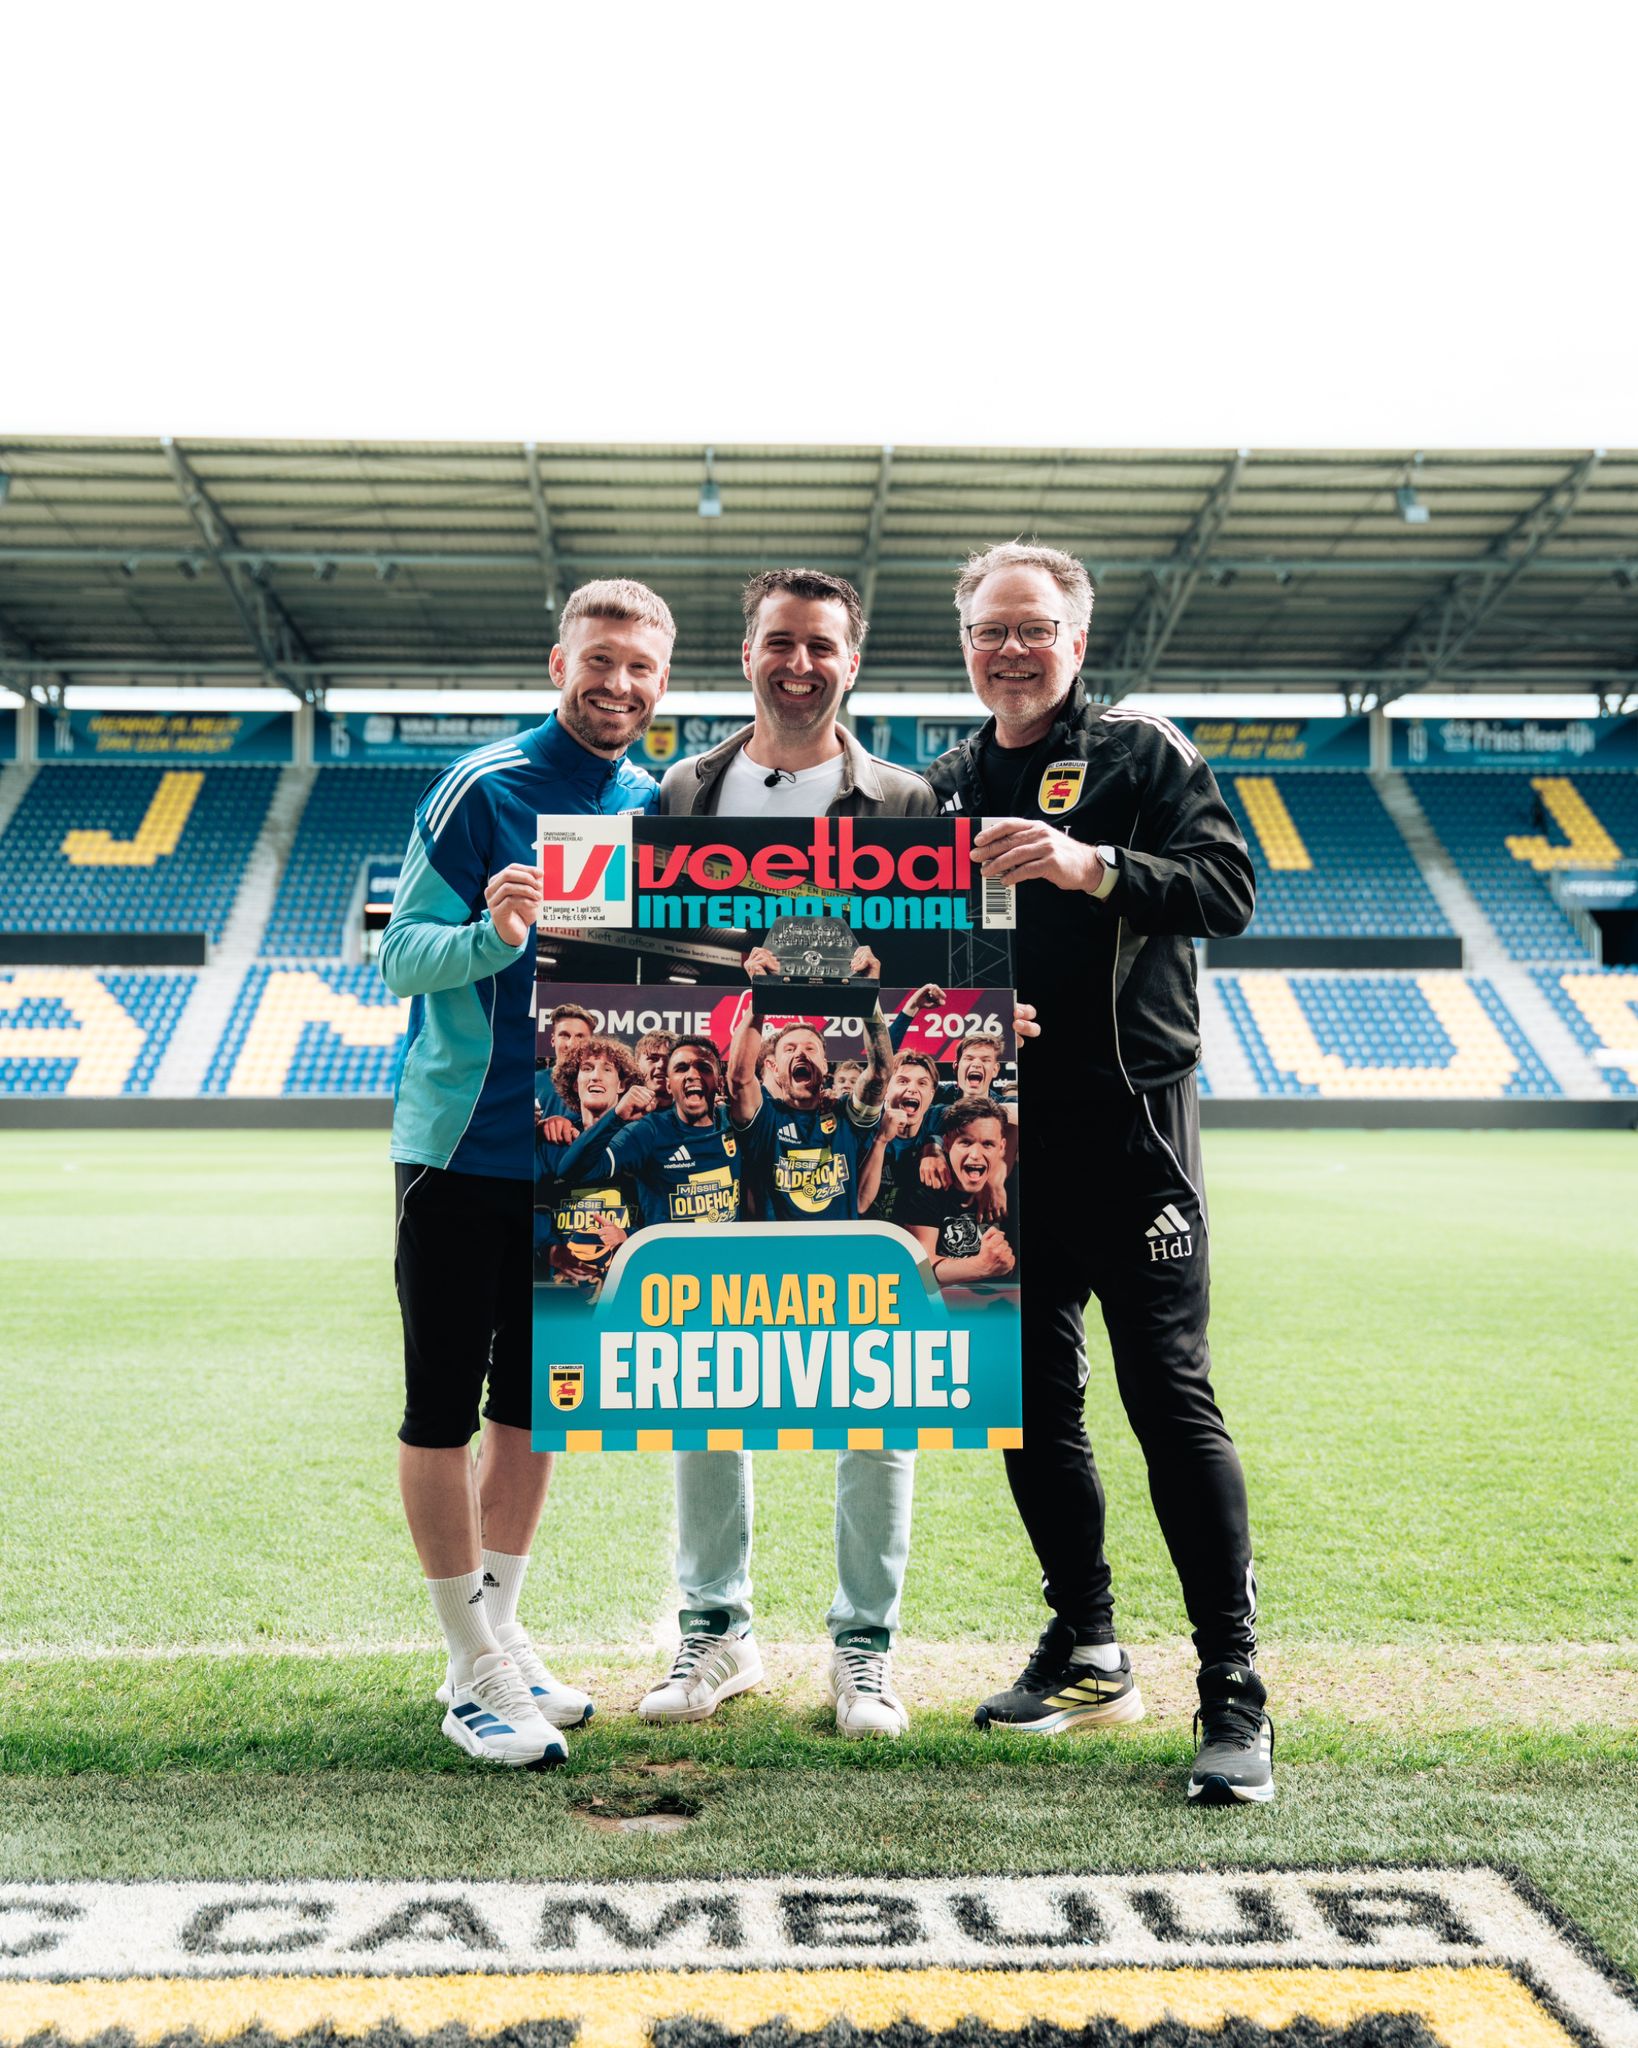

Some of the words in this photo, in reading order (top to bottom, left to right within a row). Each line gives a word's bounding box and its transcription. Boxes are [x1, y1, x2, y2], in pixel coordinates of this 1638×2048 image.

[638, 816, 971, 890] voetbal
[543, 844, 626, 902] VI
[638, 895, 974, 929] INTERNATIONAL
[587, 928, 613, 944] Kieft
[924, 1013, 1004, 1038] 2026
[1147, 1234, 1193, 1262] HdJ
[640, 1272, 701, 1328] OP
[711, 1273, 837, 1326] NAAR
[847, 1273, 901, 1325] DE
[600, 1329, 972, 1410] EREDIVISIE!
[688, 1619, 711, 1627] adidas
[847, 1637, 872, 1645] adidas
[180, 1886, 1484, 1956] CAMBUUR
